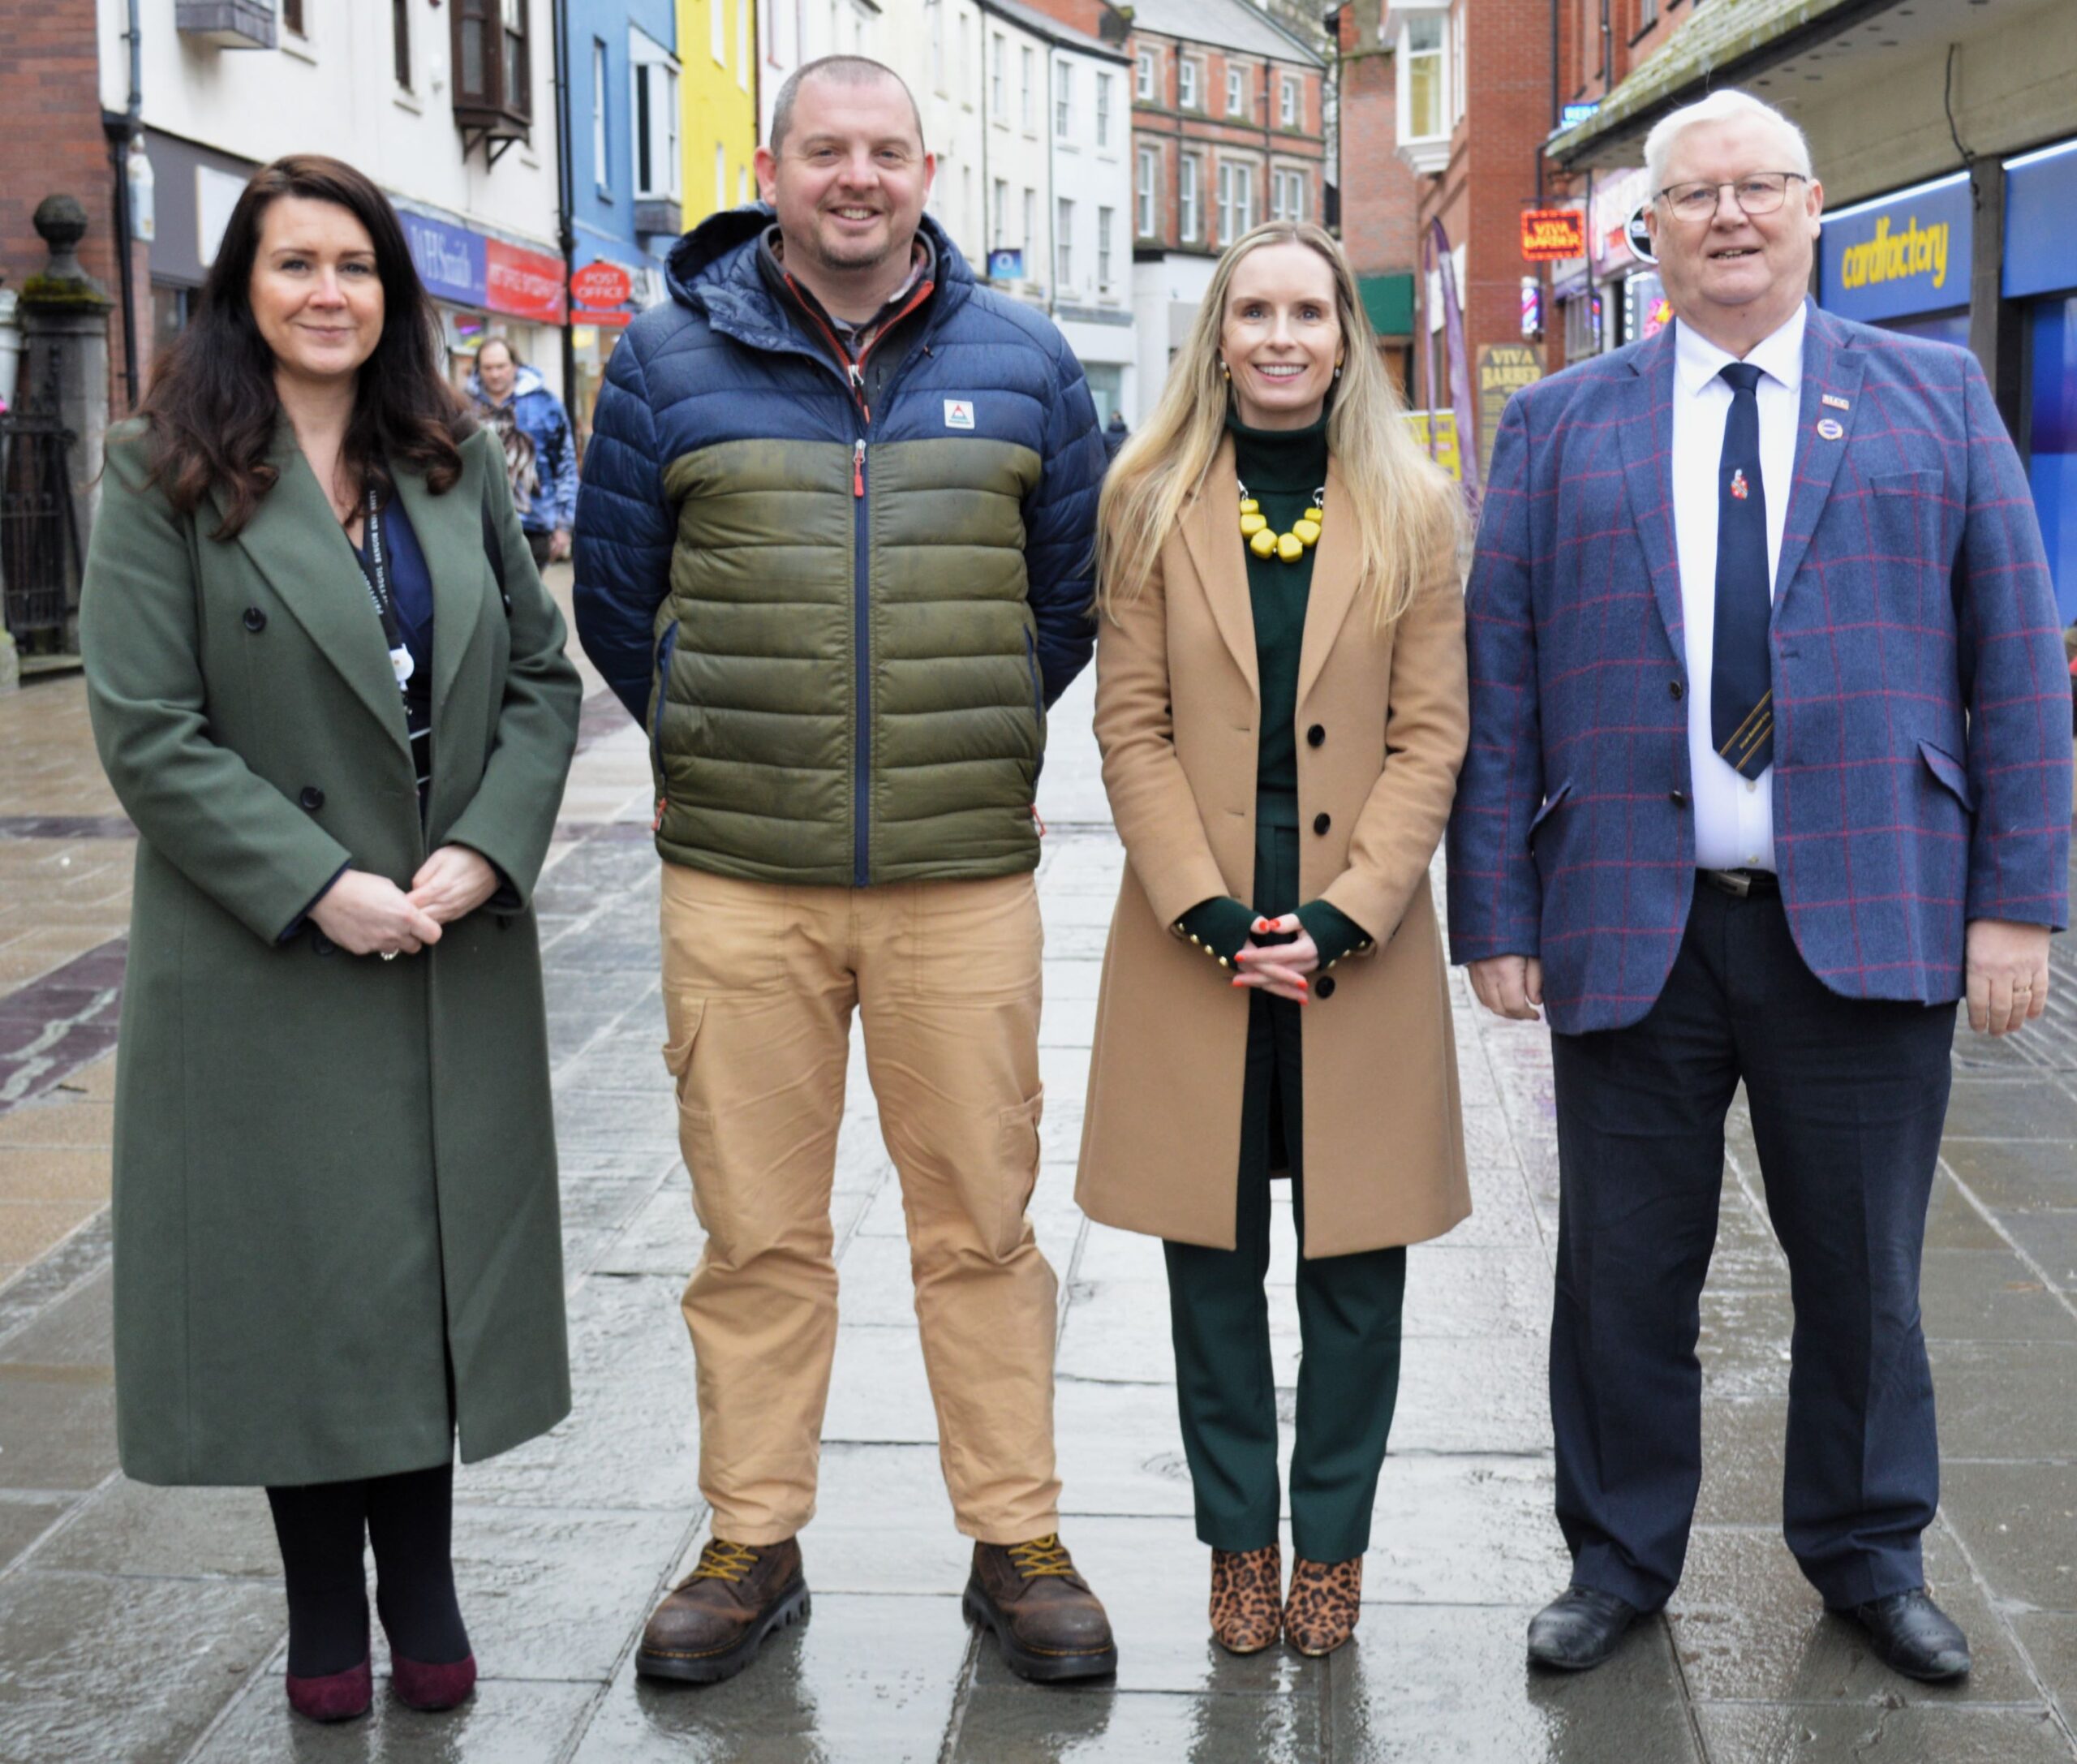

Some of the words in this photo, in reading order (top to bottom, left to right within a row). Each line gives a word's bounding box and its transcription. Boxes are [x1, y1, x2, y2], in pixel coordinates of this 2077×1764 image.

[1533, 221, 1570, 235] VIVA
[1842, 214, 1949, 289] cardfactory
[583, 272, 620, 284] POST
[577, 286, 625, 299] OFFICE
[1491, 349, 1535, 364] VIVA
